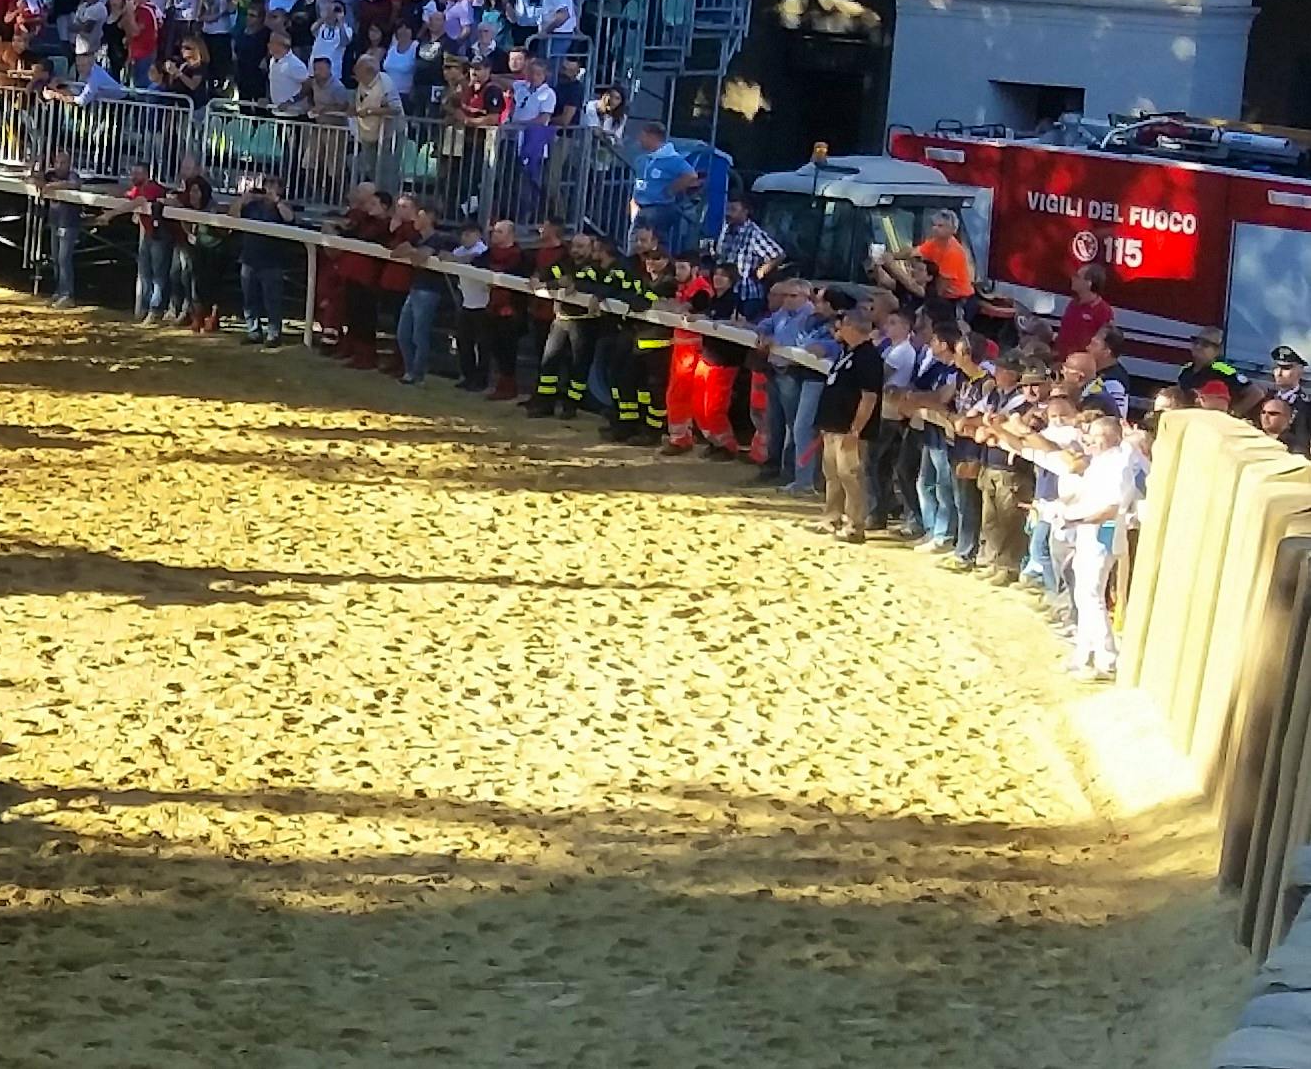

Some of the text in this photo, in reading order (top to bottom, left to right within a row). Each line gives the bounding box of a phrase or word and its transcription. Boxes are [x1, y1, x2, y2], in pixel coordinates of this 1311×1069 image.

[1028, 191, 1196, 234] VIGILI DEL FUOCO
[1103, 235, 1142, 267] 115
